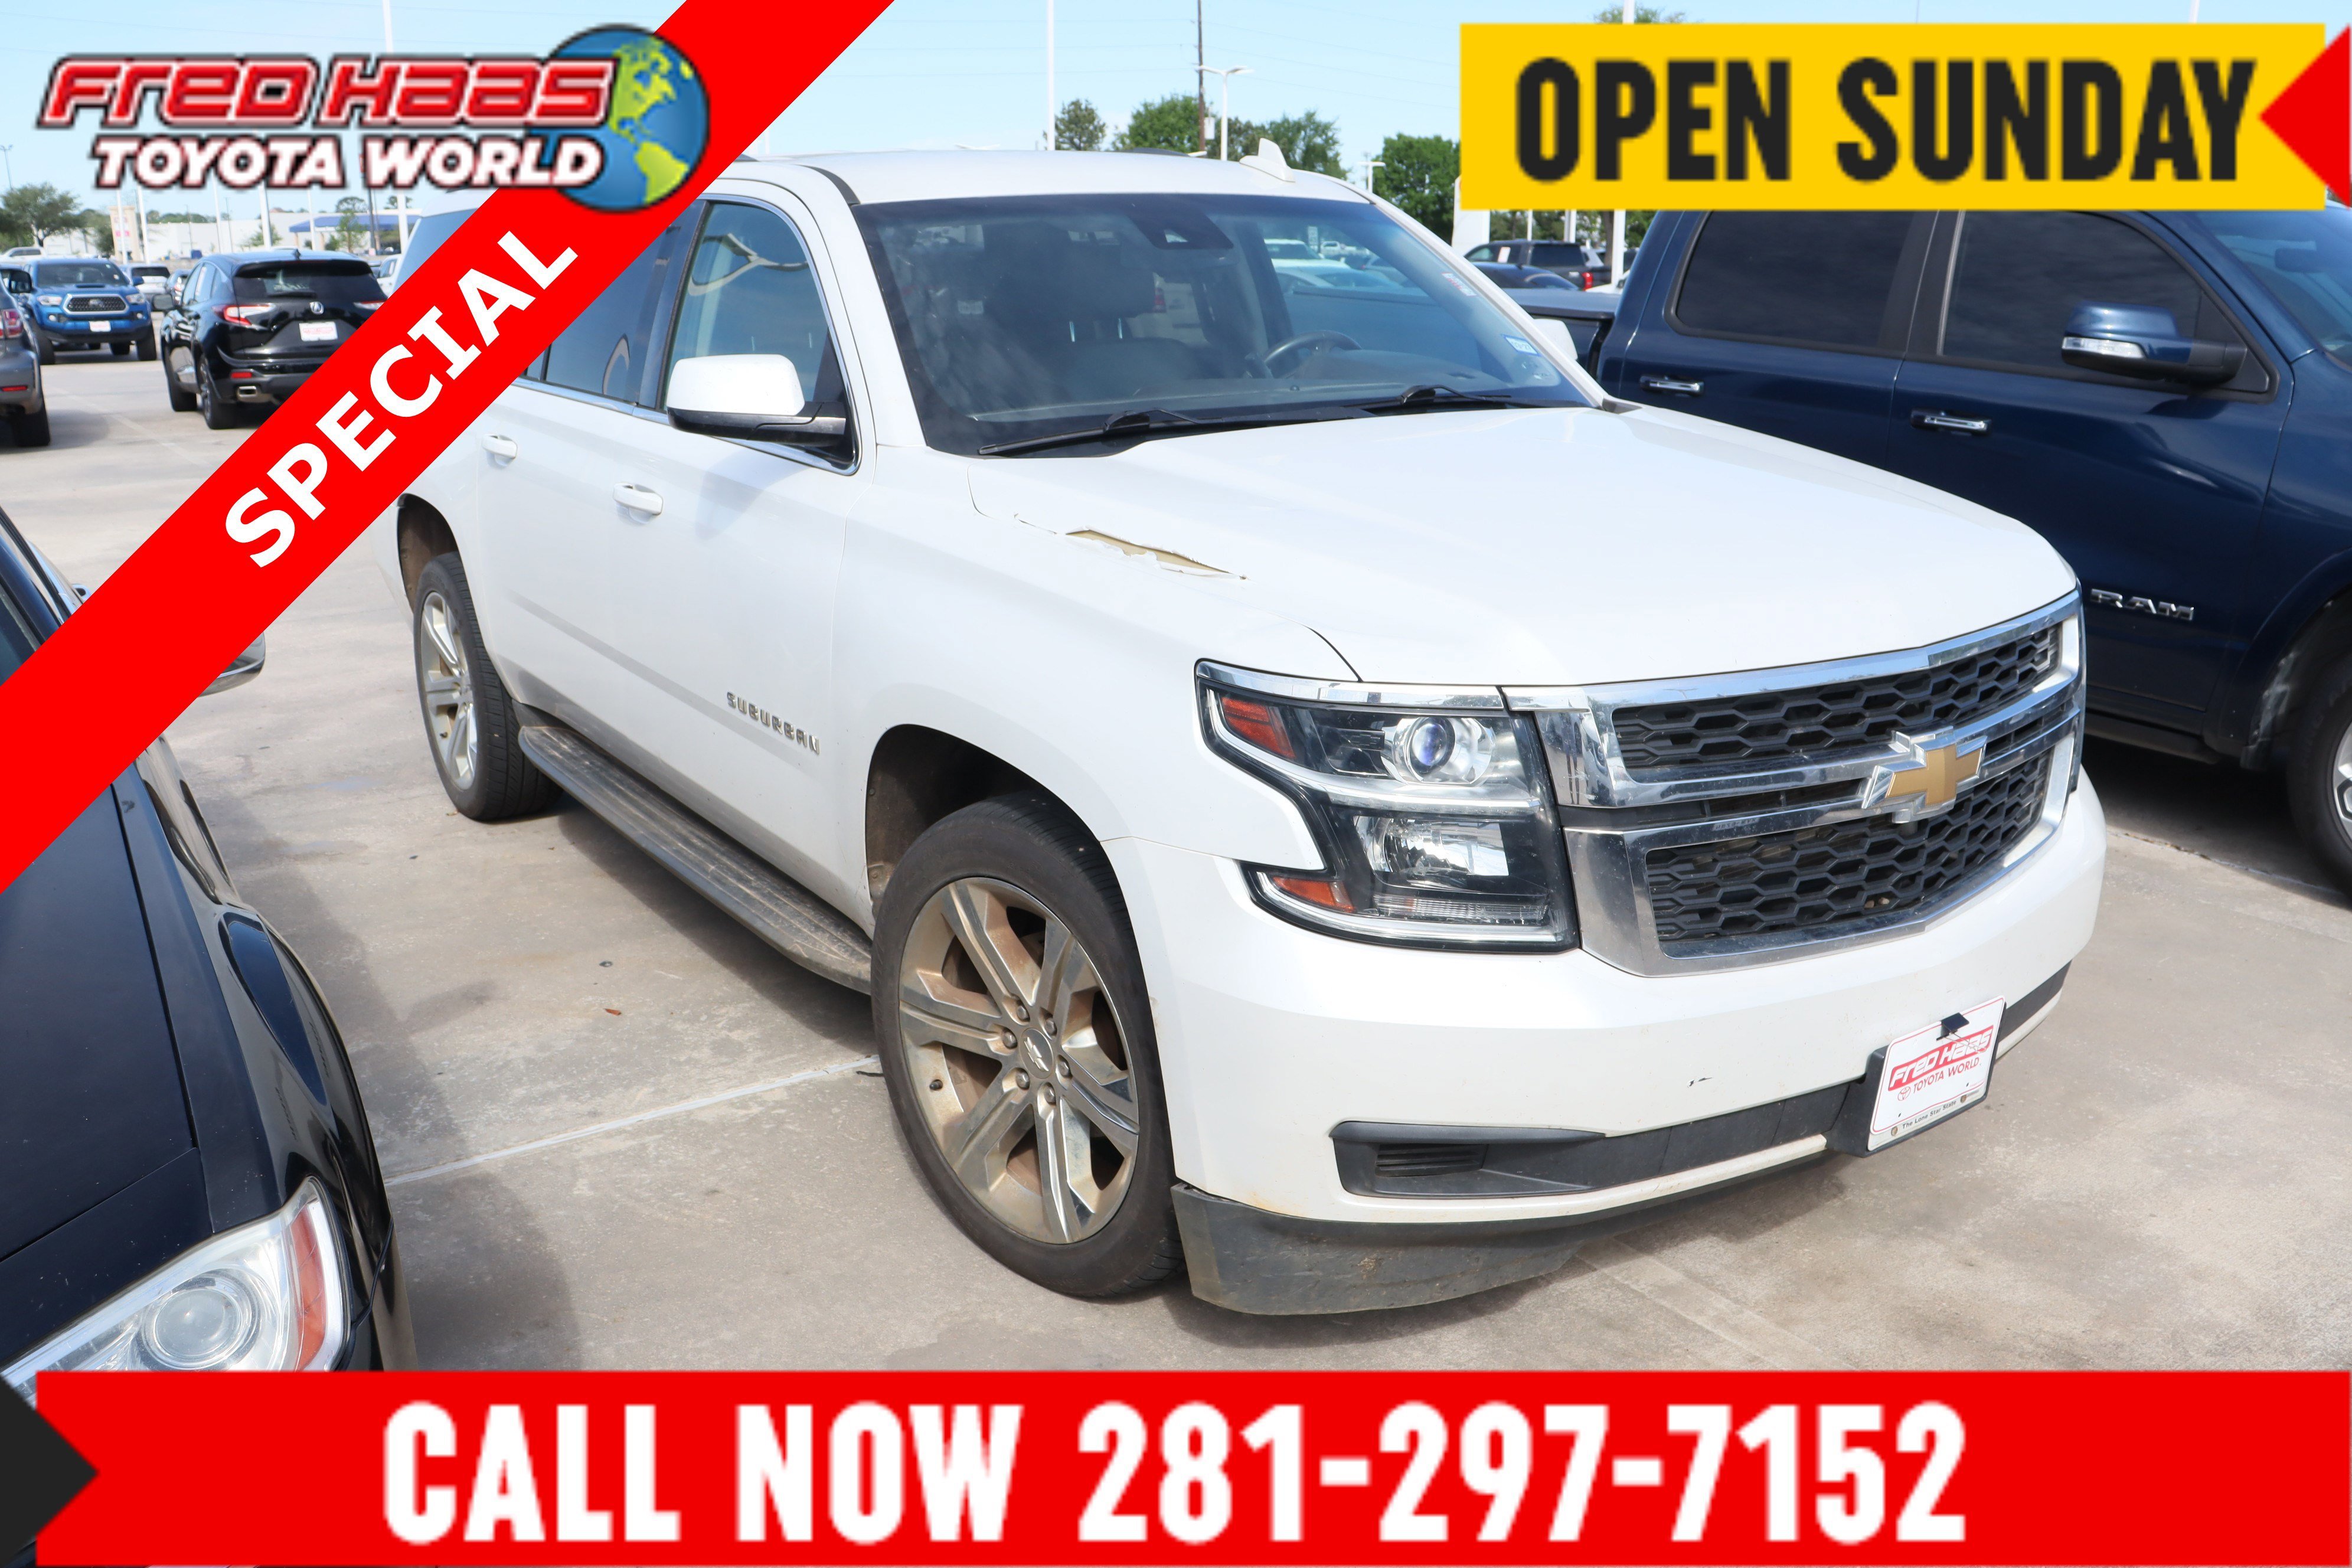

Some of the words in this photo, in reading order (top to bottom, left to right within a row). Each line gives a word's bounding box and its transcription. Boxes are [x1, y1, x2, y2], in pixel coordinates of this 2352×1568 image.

[2090, 588, 2194, 620] RAM
[726, 691, 821, 755] SUBURBAN
[1913, 1070, 1944, 1094] TOYOTA
[1948, 1057, 1980, 1077] WORLD
[1902, 1121, 1913, 1129] The
[1915, 1114, 1929, 1125] Lone
[1929, 1108, 1941, 1116] Star
[1942, 1100, 1957, 1110] State
